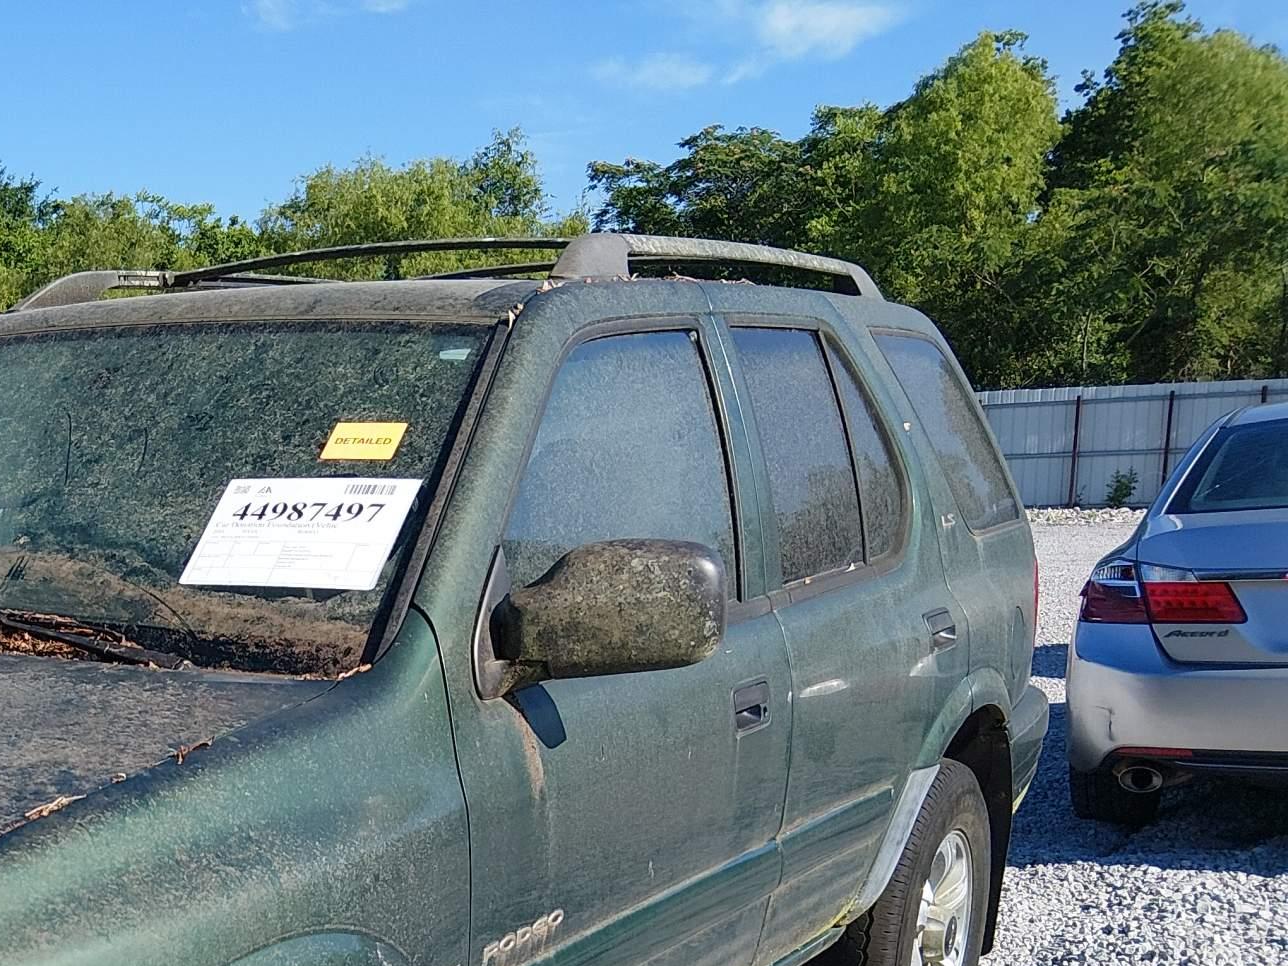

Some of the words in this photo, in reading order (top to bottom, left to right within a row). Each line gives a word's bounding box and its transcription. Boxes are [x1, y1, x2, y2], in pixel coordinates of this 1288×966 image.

[334, 437, 392, 445] DETAILED
[232, 502, 386, 522] 44987497
[941, 513, 956, 527] LS
[1164, 629, 1229, 638] Accord
